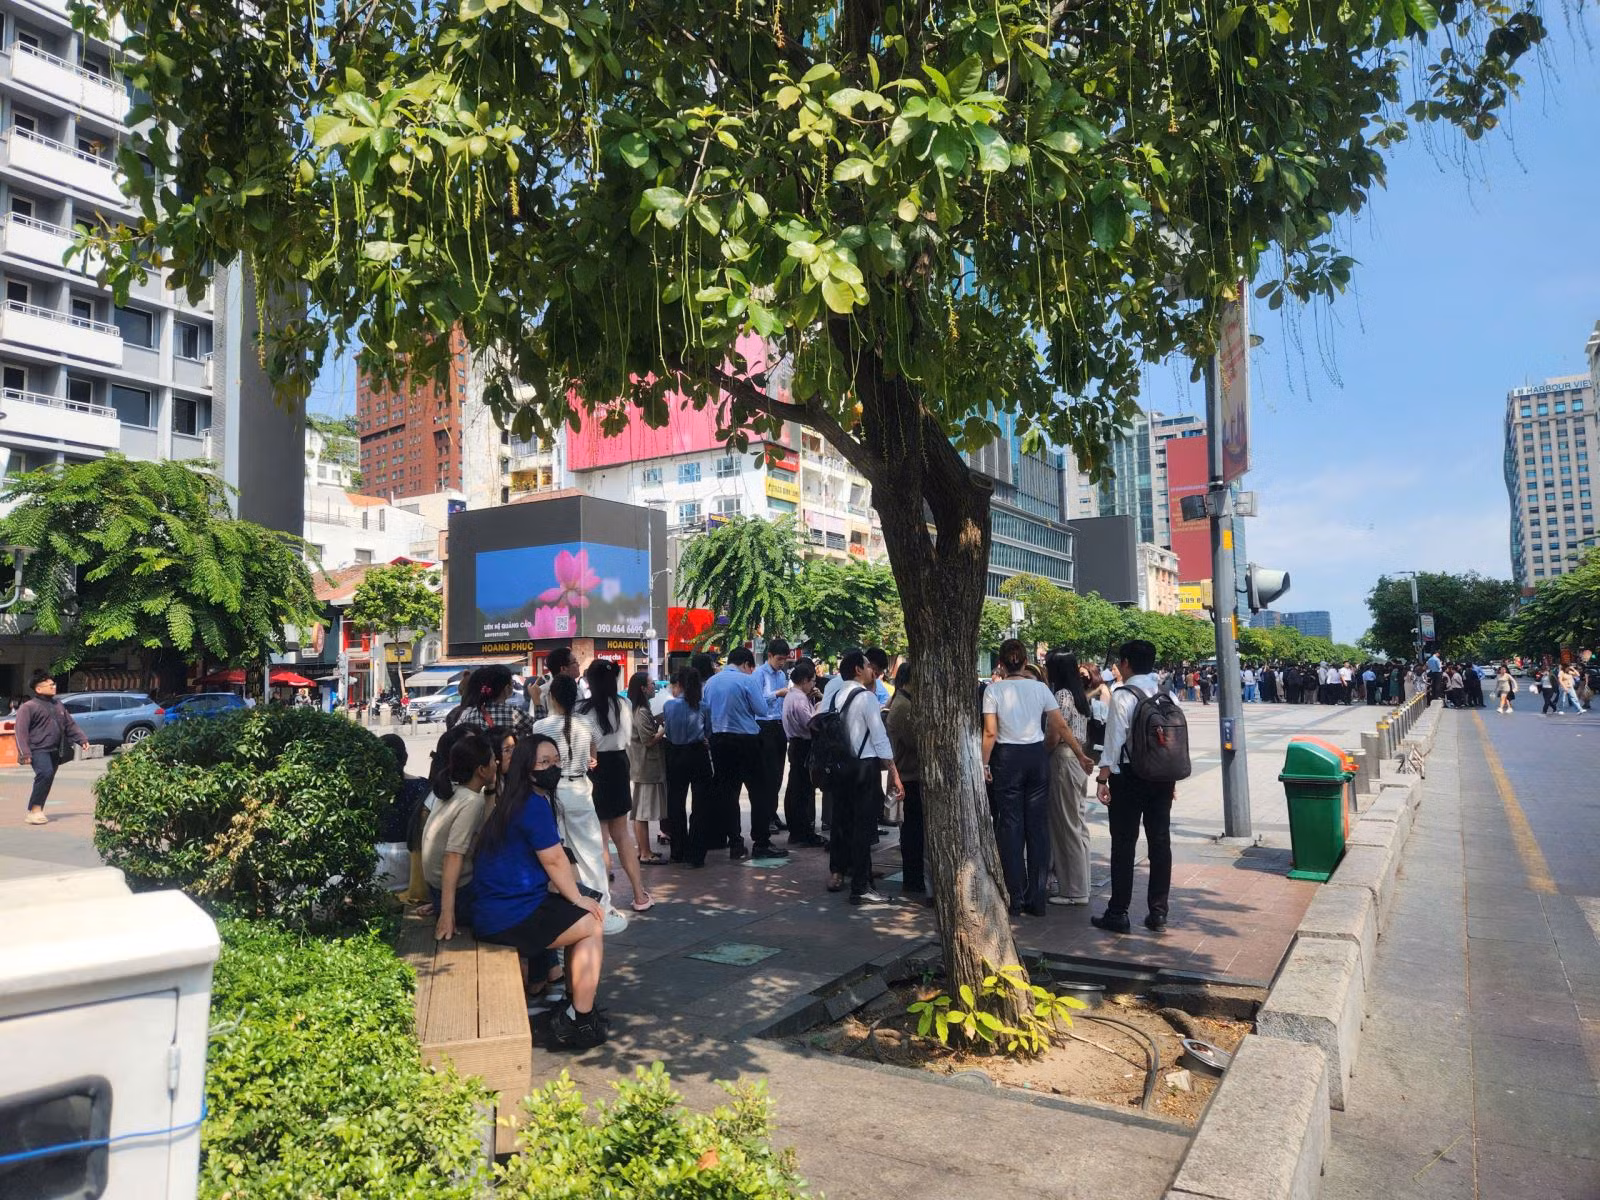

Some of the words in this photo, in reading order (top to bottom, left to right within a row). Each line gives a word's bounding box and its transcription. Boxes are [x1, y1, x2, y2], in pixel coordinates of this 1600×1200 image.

[1526, 383, 1570, 394] HARBOUR
[597, 624, 610, 632] 090
[612, 625, 625, 633] 464
[482, 644, 510, 652] HOANG
